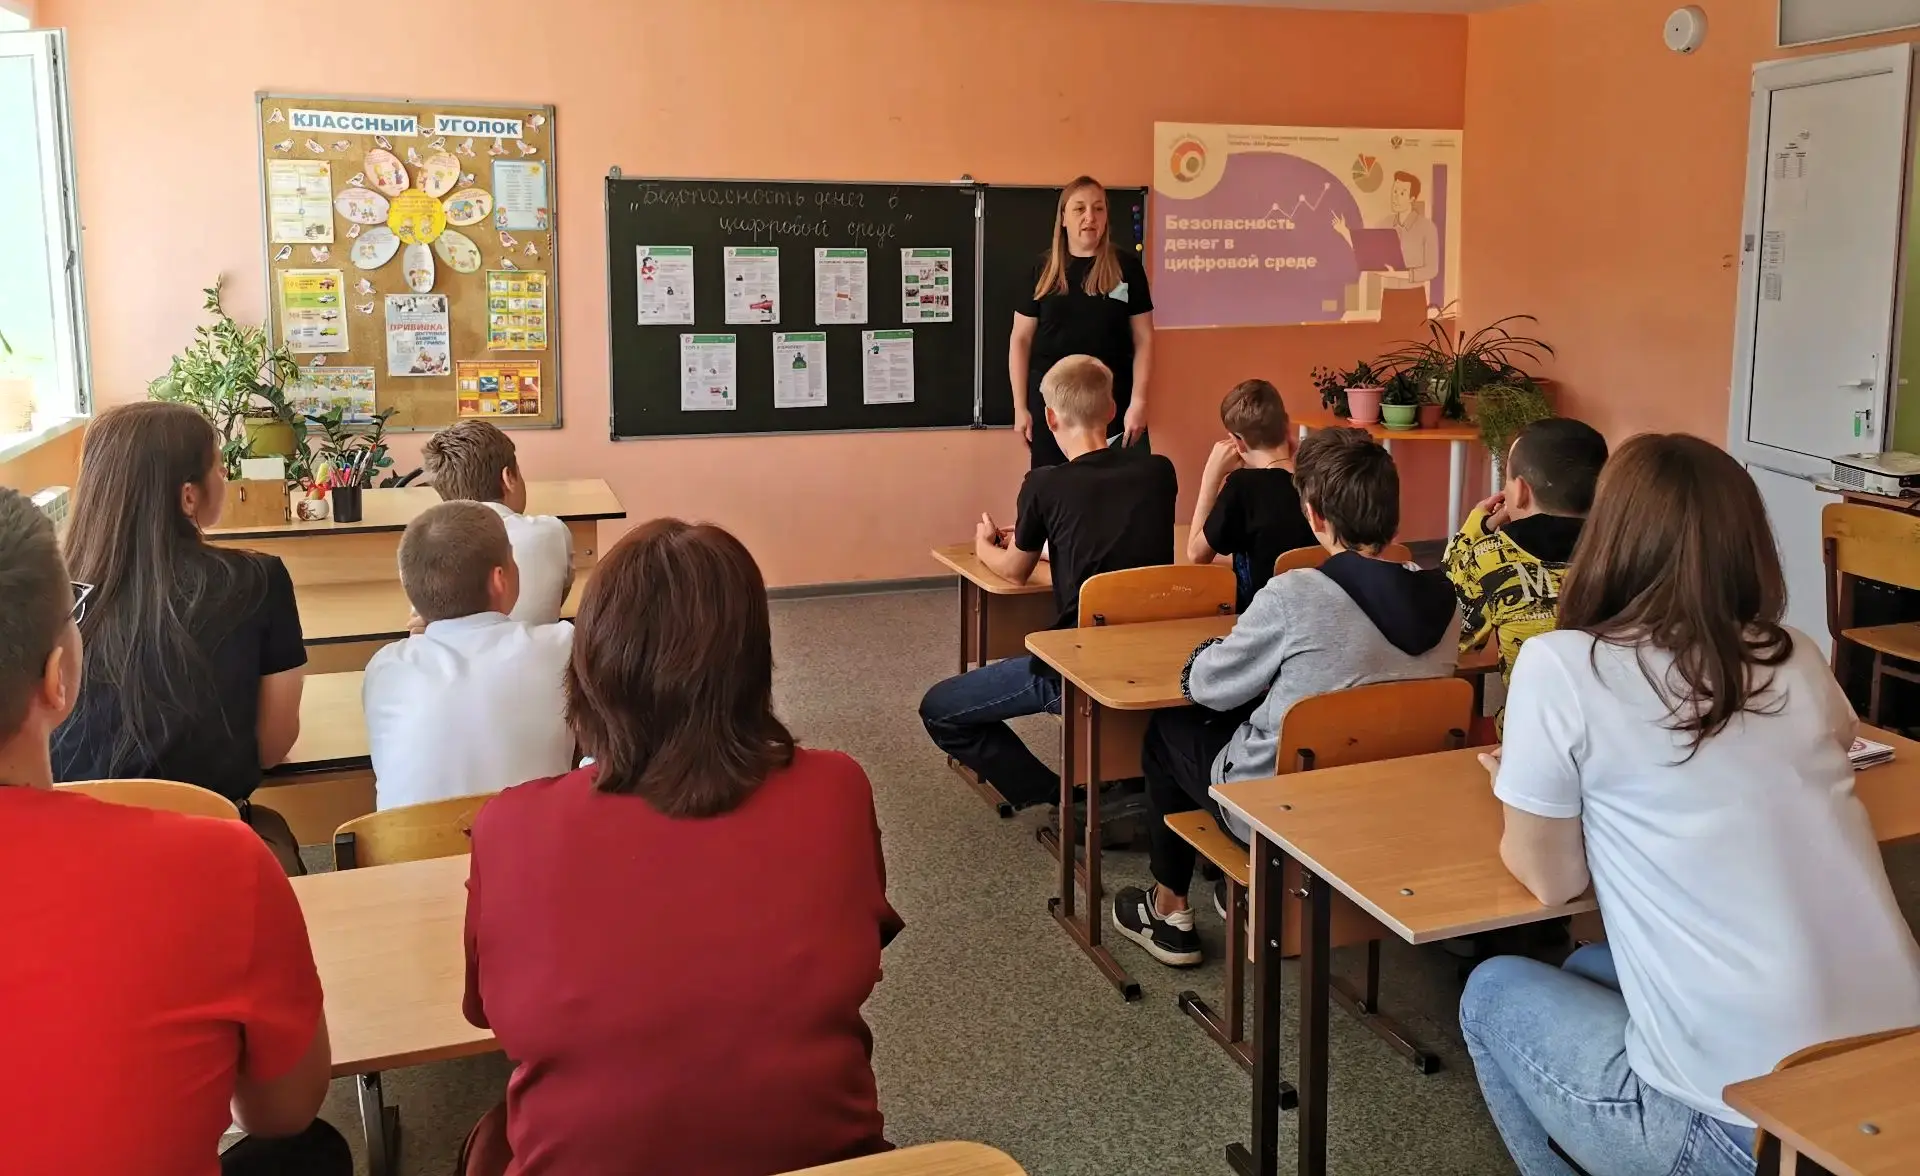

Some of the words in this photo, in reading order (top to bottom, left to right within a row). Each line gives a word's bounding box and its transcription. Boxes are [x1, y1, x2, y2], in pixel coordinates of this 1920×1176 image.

[292, 112, 415, 133] КЛАССНЫЙ
[438, 117, 520, 135] УГОЛОК
[815, 191, 865, 213] денег
[719, 215, 830, 243] цифровой
[1164, 214, 1296, 231] Безопасность
[1164, 237, 1220, 252] денег
[1224, 239, 1235, 250] в
[1164, 254, 1259, 273] цифровой
[1264, 256, 1318, 272] среде
